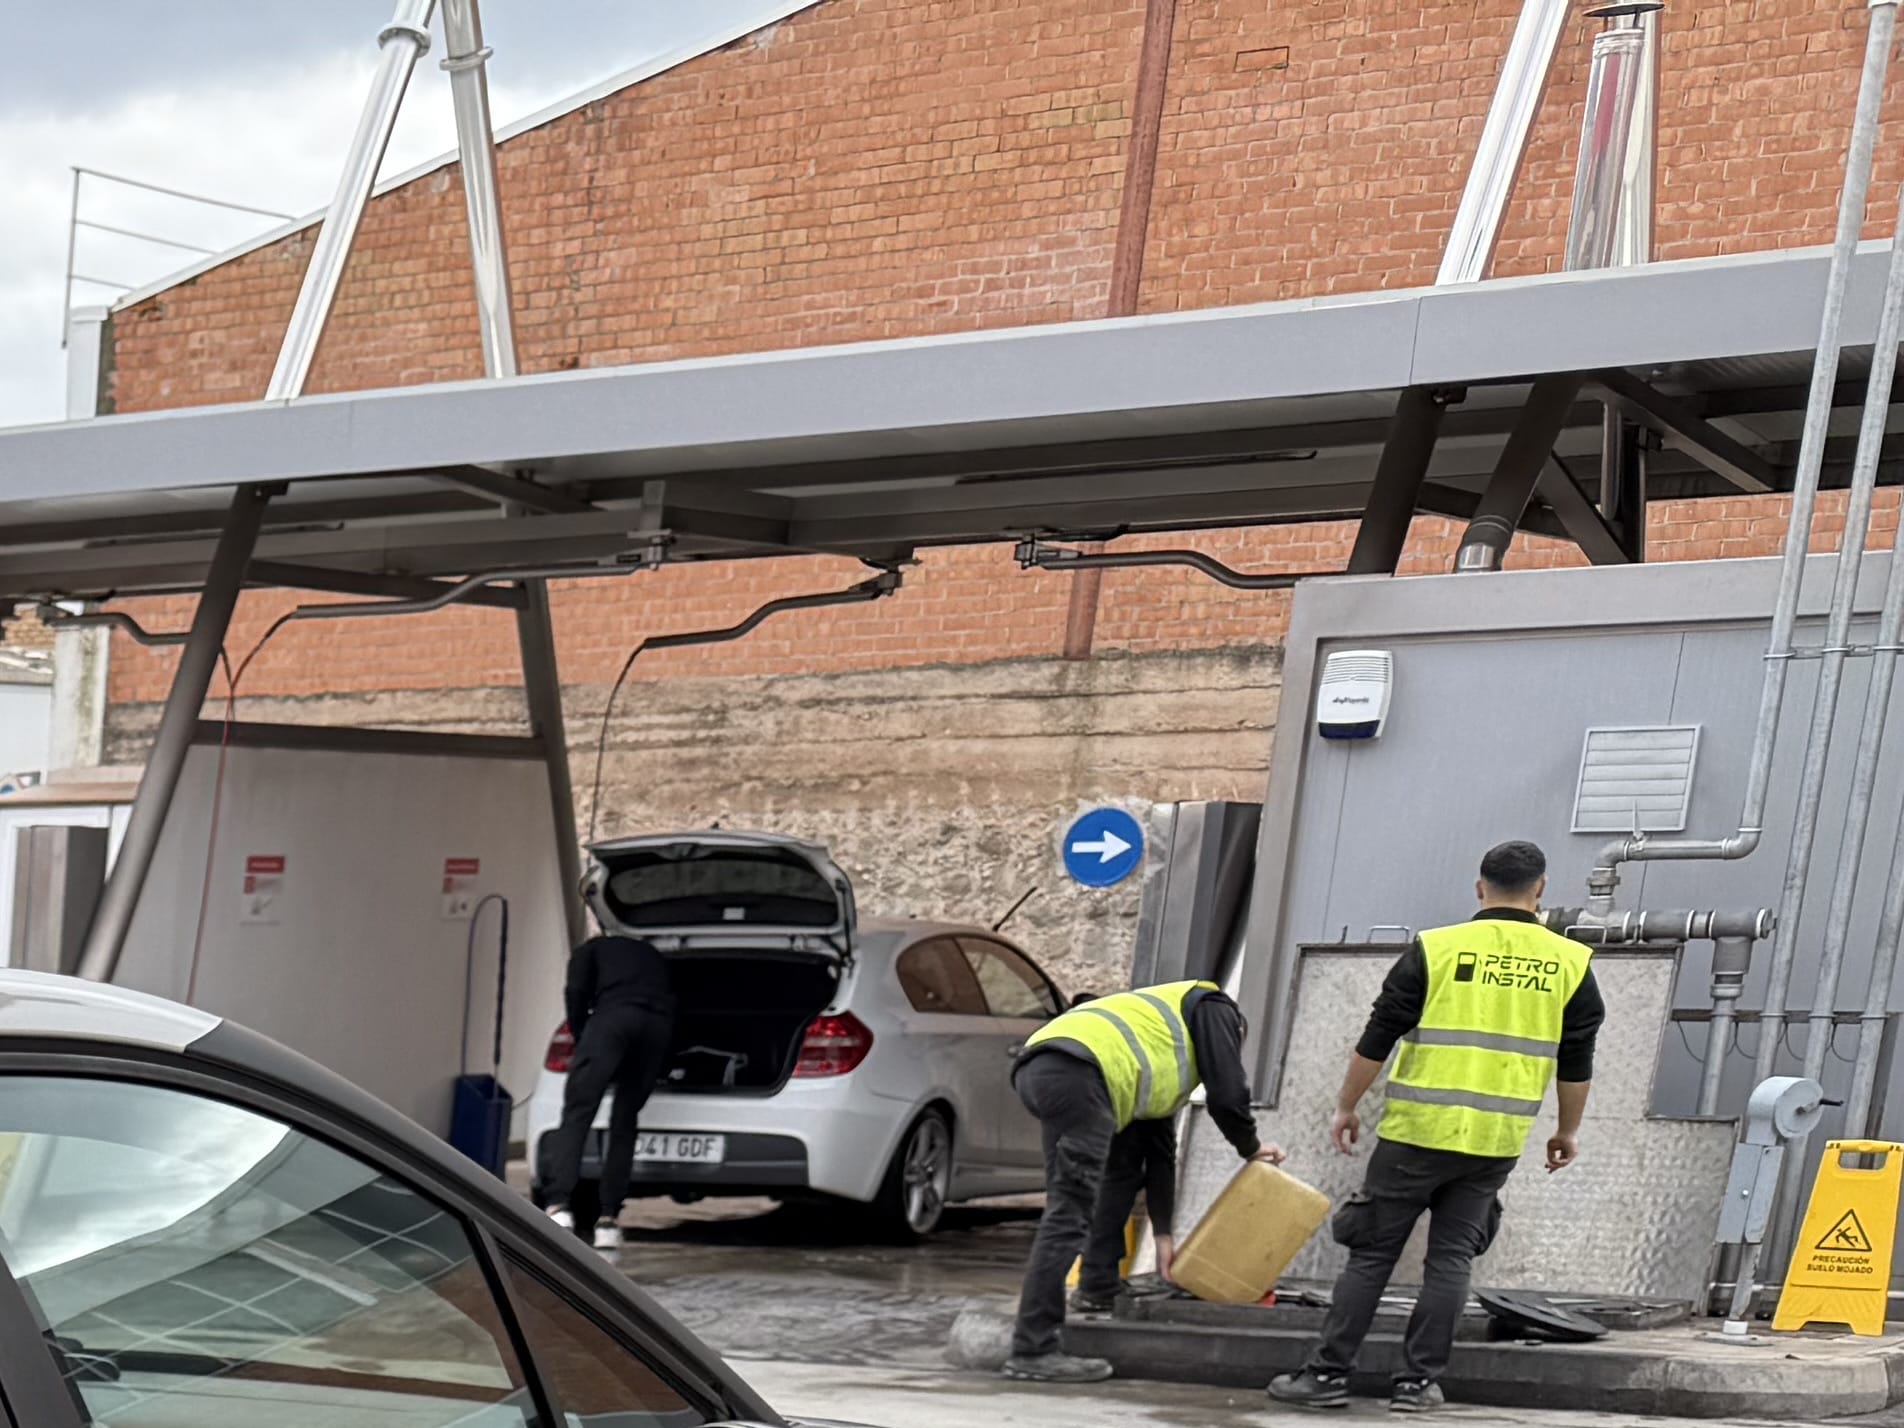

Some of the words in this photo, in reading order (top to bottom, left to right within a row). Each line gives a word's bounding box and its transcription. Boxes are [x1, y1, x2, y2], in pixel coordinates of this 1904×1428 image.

[1485, 954, 1559, 975] PETRO
[1482, 970, 1552, 992] INSTAL
[677, 1137, 716, 1158] GDF
[1812, 1255, 1871, 1265] PRECAUCIÓN
[1836, 1265, 1874, 1274] MOJADO
